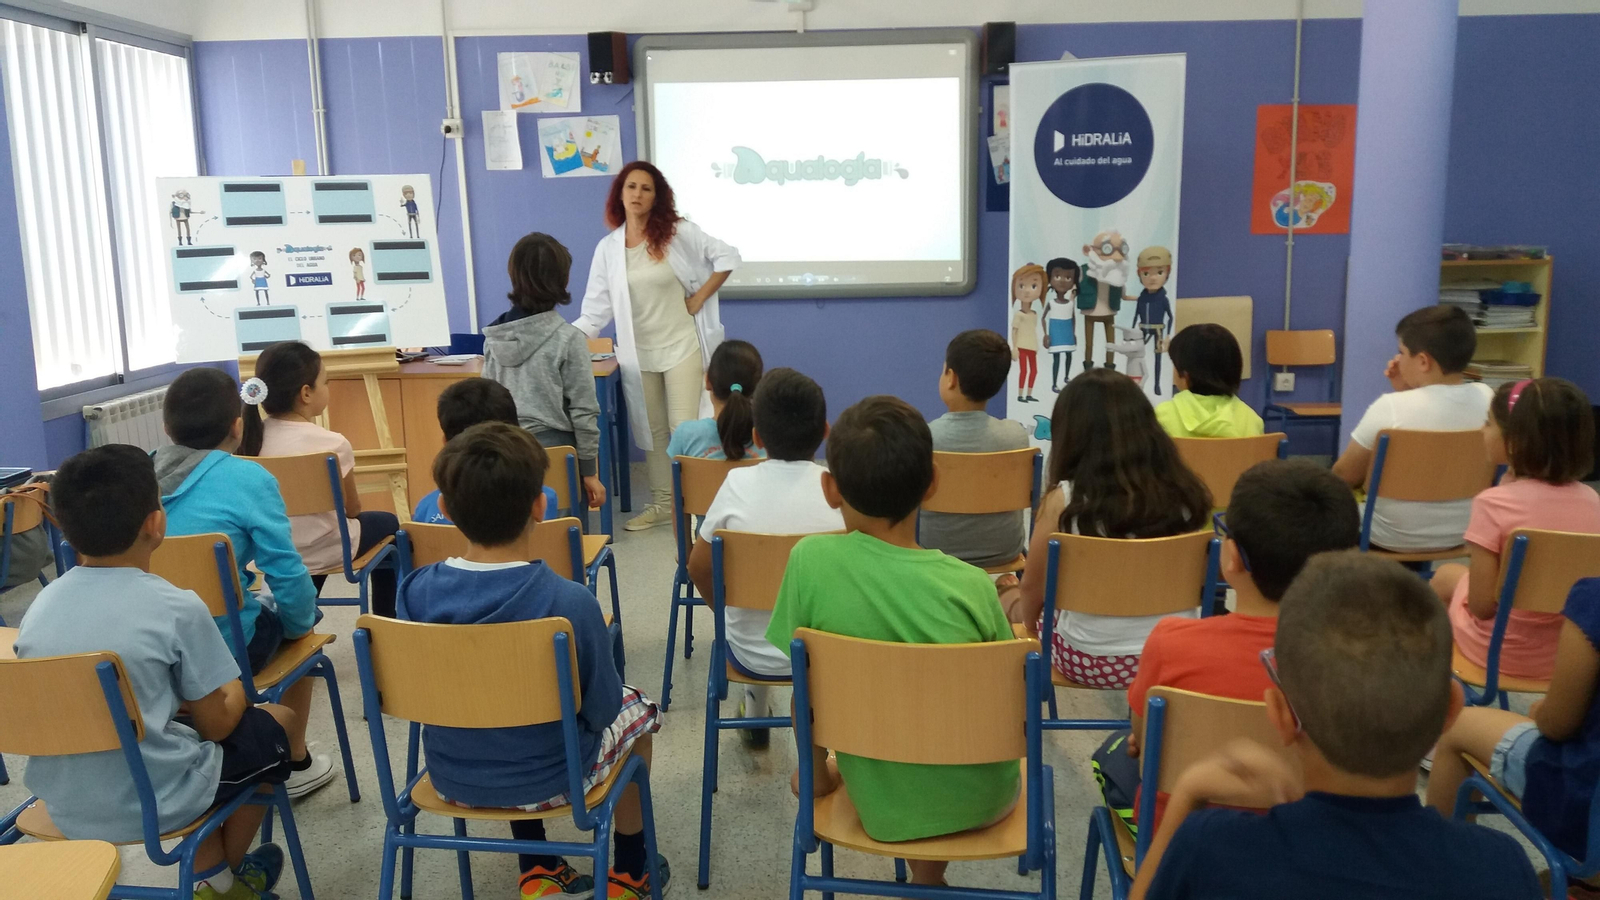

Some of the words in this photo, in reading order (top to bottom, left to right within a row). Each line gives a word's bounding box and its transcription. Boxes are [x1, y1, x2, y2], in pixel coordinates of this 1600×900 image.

[1054, 158, 1063, 166] Al
[1064, 156, 1096, 166] cuidado
[1097, 156, 1111, 165] del
[1111, 156, 1133, 166] agua
